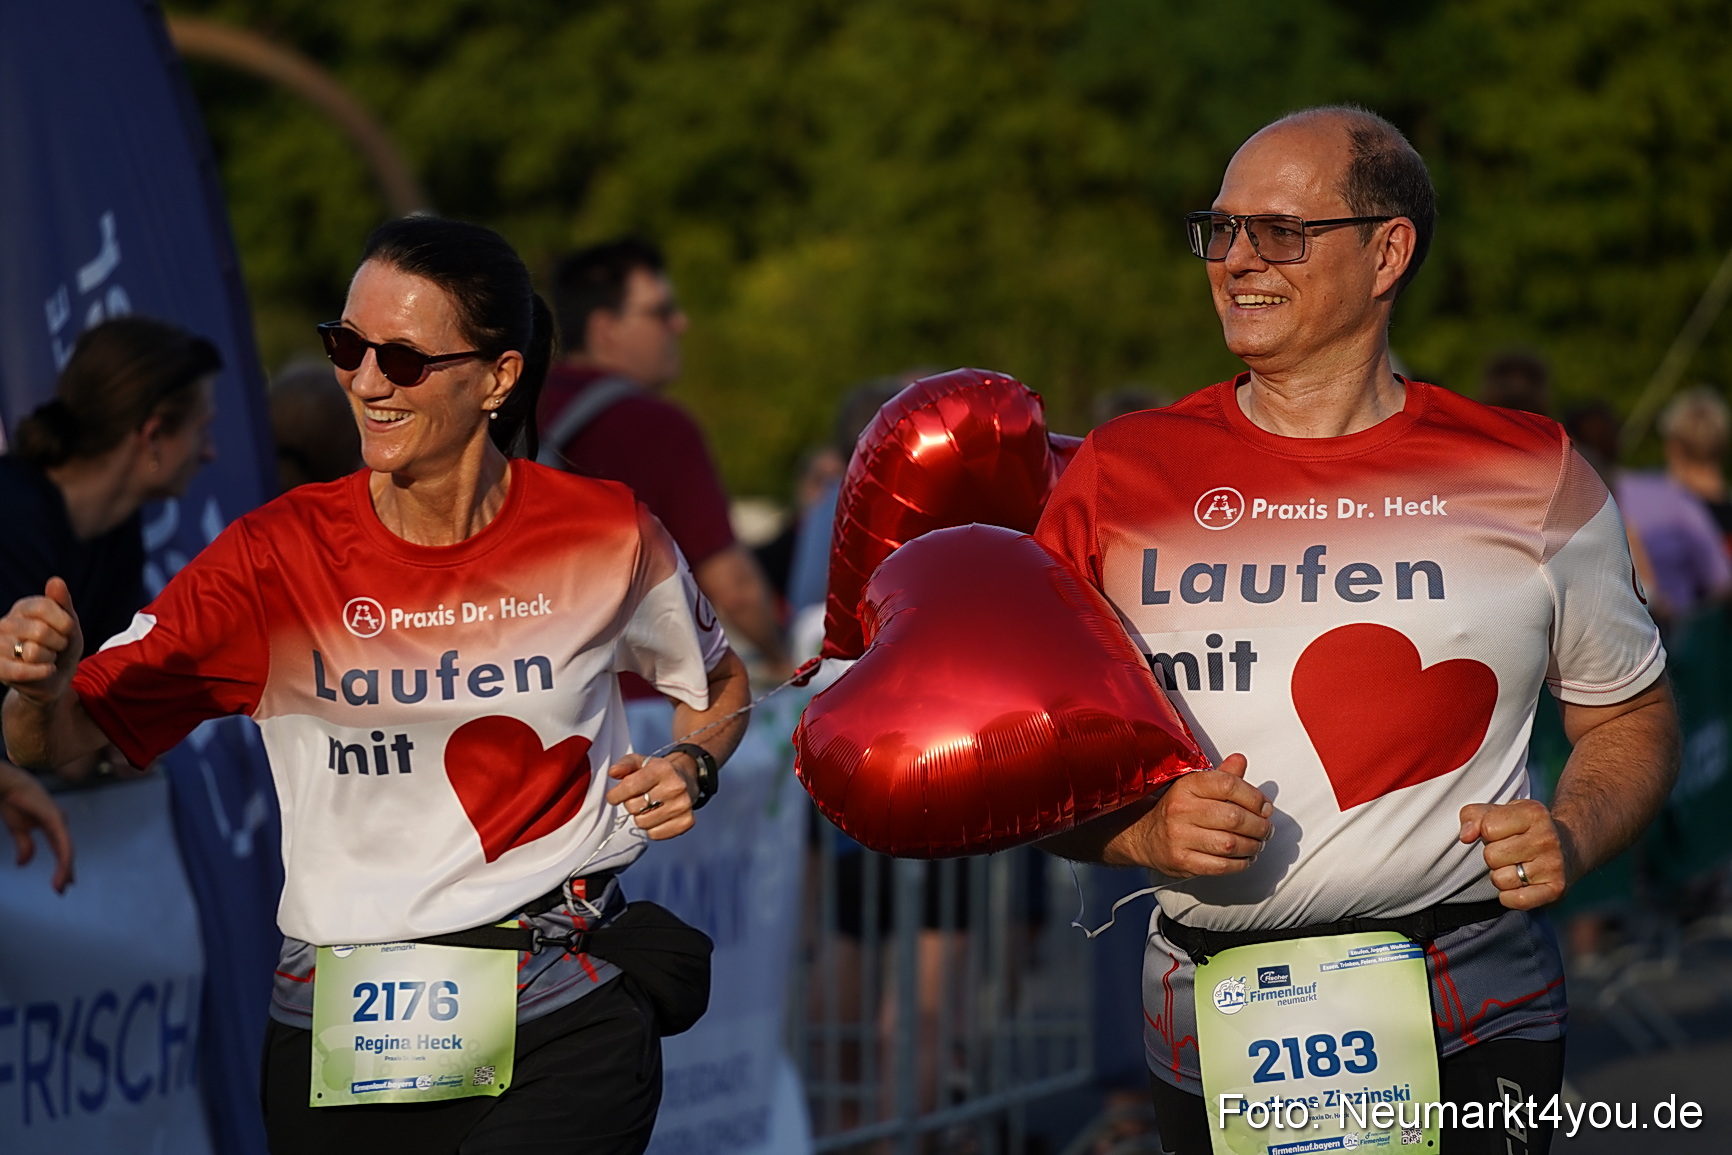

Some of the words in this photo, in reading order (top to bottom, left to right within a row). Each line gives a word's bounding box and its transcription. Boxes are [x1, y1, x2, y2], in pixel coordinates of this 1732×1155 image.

[1252, 498, 1328, 520] Praxis
[1337, 498, 1375, 519] Dr.
[1384, 495, 1448, 518] Heck
[1141, 545, 1445, 605] Laufen
[391, 604, 456, 630] Praxis
[462, 602, 494, 624] Dr.
[500, 593, 552, 619] Heck
[312, 649, 554, 706] Laufen
[1143, 633, 1258, 692] mit
[328, 731, 414, 776] mit
[1250, 982, 1317, 1002] Firmenlauf
[1263, 973, 1289, 982] Fischer
[353, 980, 459, 1023] 2176
[1277, 993, 1317, 1006] neumarkt
[355, 1035, 412, 1054] Regina
[417, 1034, 463, 1050] Heck
[1248, 1030, 1378, 1083] 2183
[1271, 1139, 1341, 1155] firmenlauf.bayern
